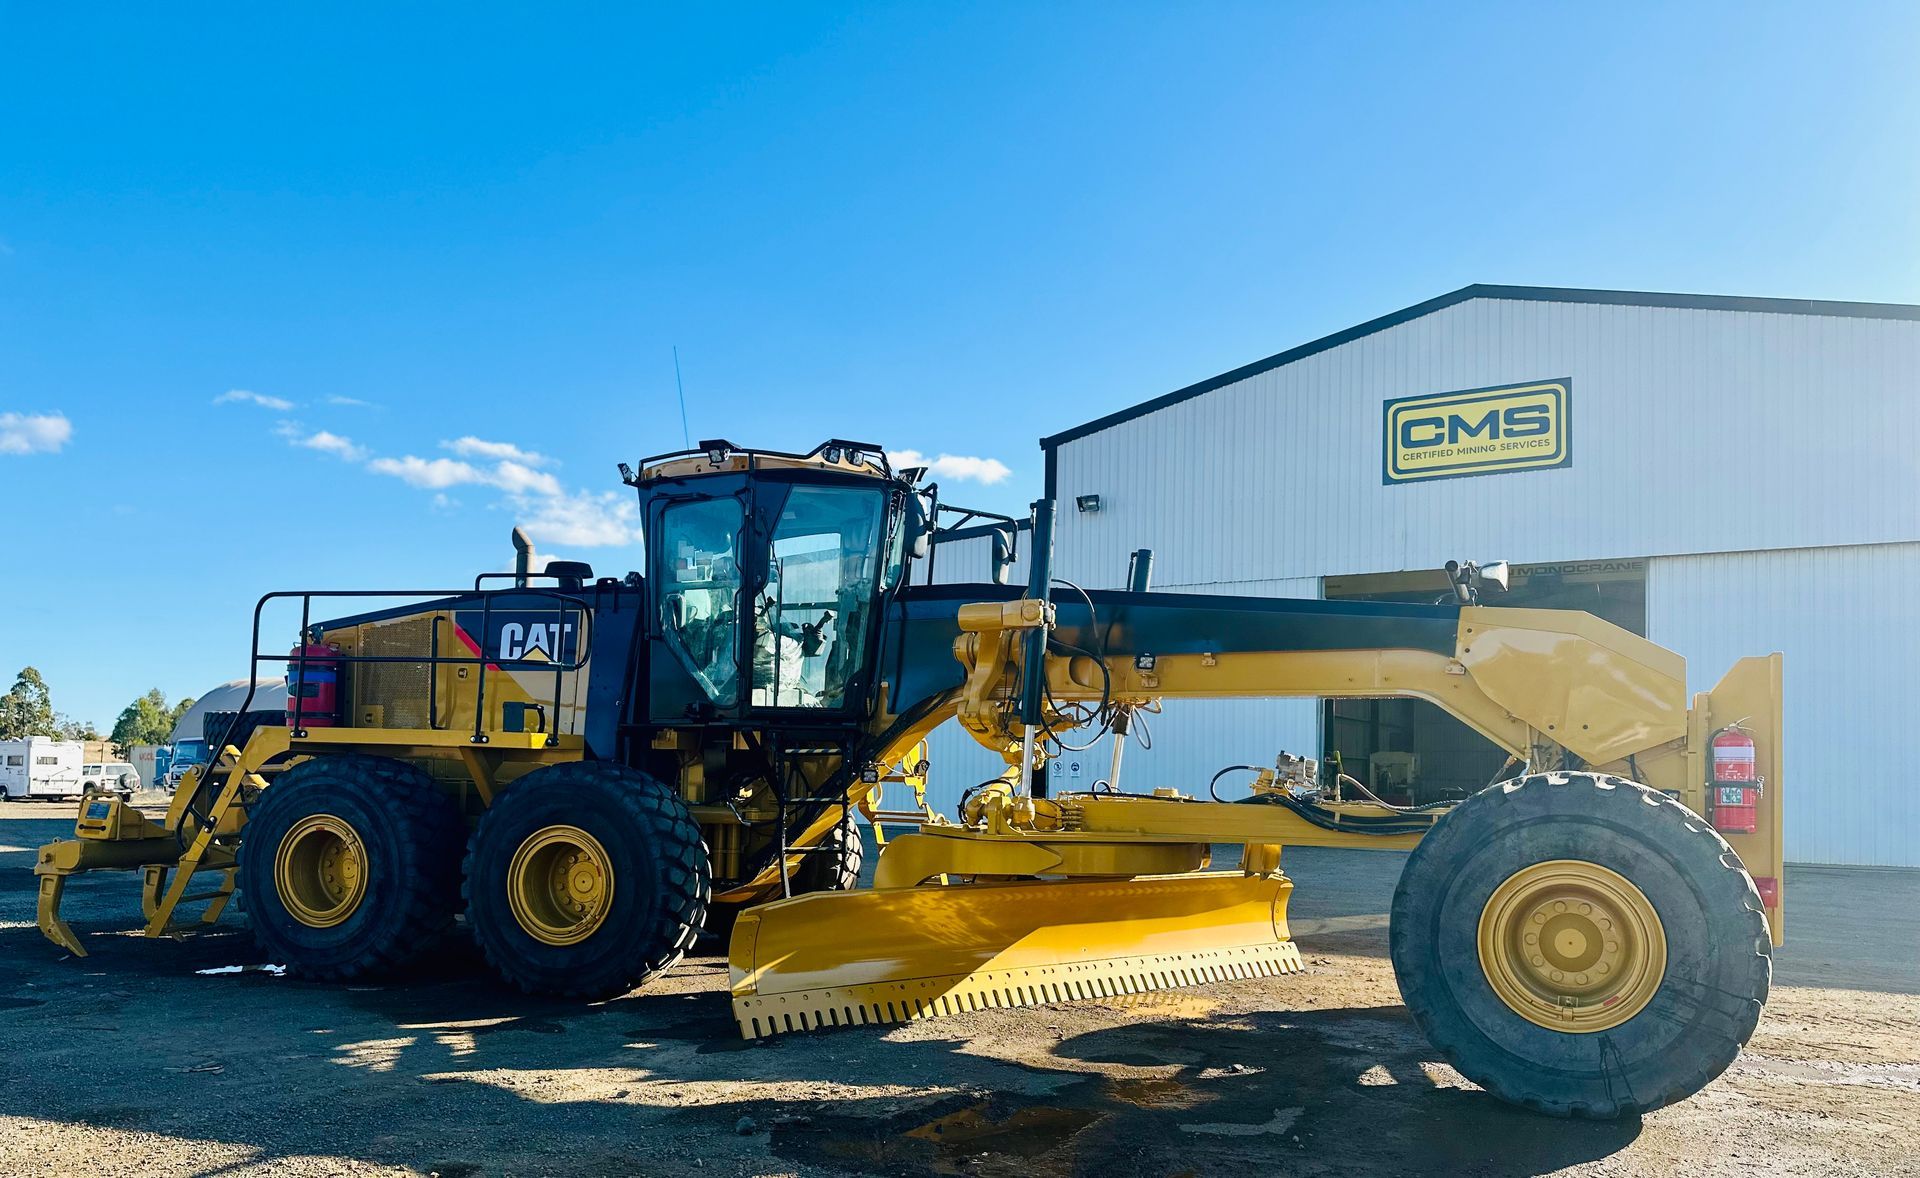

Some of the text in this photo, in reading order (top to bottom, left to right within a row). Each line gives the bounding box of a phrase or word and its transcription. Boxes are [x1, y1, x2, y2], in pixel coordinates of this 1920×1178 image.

[1401, 404, 1550, 449] CMS
[1403, 438, 1551, 461] CERTIFIED MINING SERVICES
[1518, 561, 1643, 576] MONOCRANE
[499, 622, 572, 662] CAT
